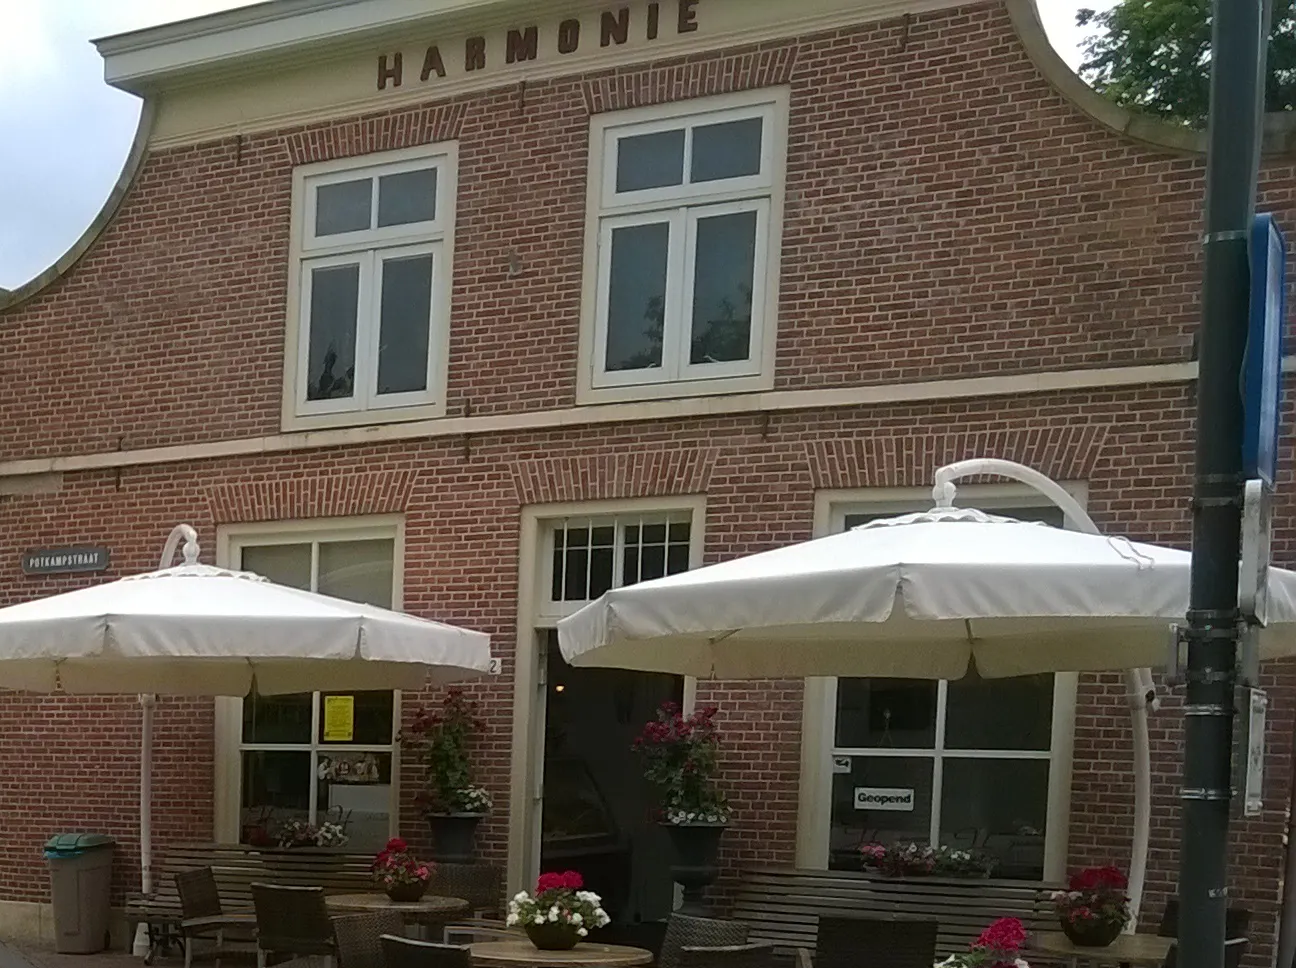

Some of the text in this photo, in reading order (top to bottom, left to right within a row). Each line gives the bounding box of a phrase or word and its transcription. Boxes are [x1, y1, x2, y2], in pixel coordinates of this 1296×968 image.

[377, 0, 700, 90] HARMONIE
[29, 552, 99, 569] POTKAMPSTRAAT
[857, 792, 912, 806] Geopend
